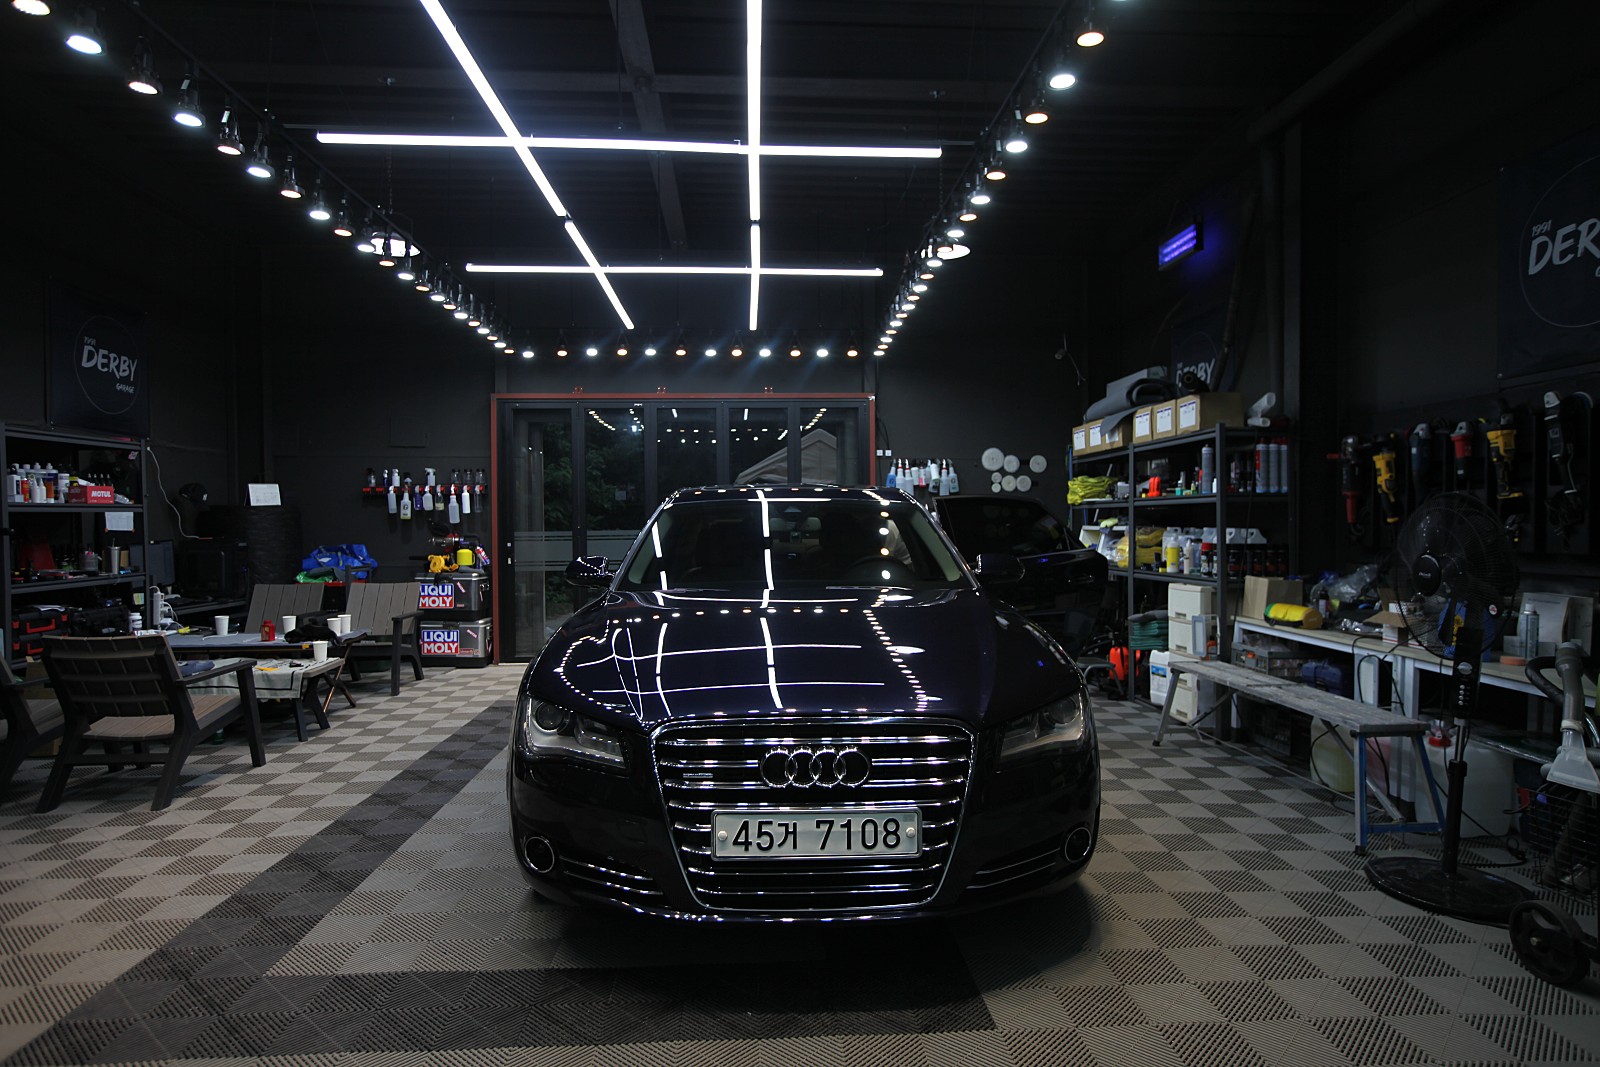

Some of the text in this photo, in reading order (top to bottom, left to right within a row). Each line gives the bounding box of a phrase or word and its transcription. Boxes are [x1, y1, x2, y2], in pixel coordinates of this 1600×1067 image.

[1531, 220, 1552, 238] 1991
[81, 344, 138, 382] DERBY
[115, 382, 135, 394] GARAGE
[91, 490, 112, 498] MOTUL
[420, 584, 453, 596] LIQUI
[419, 596, 453, 607] MOLY
[423, 631, 458, 643] LIQUI
[423, 643, 458, 654] MOLY
[732, 818, 900, 851] 45거 7108
